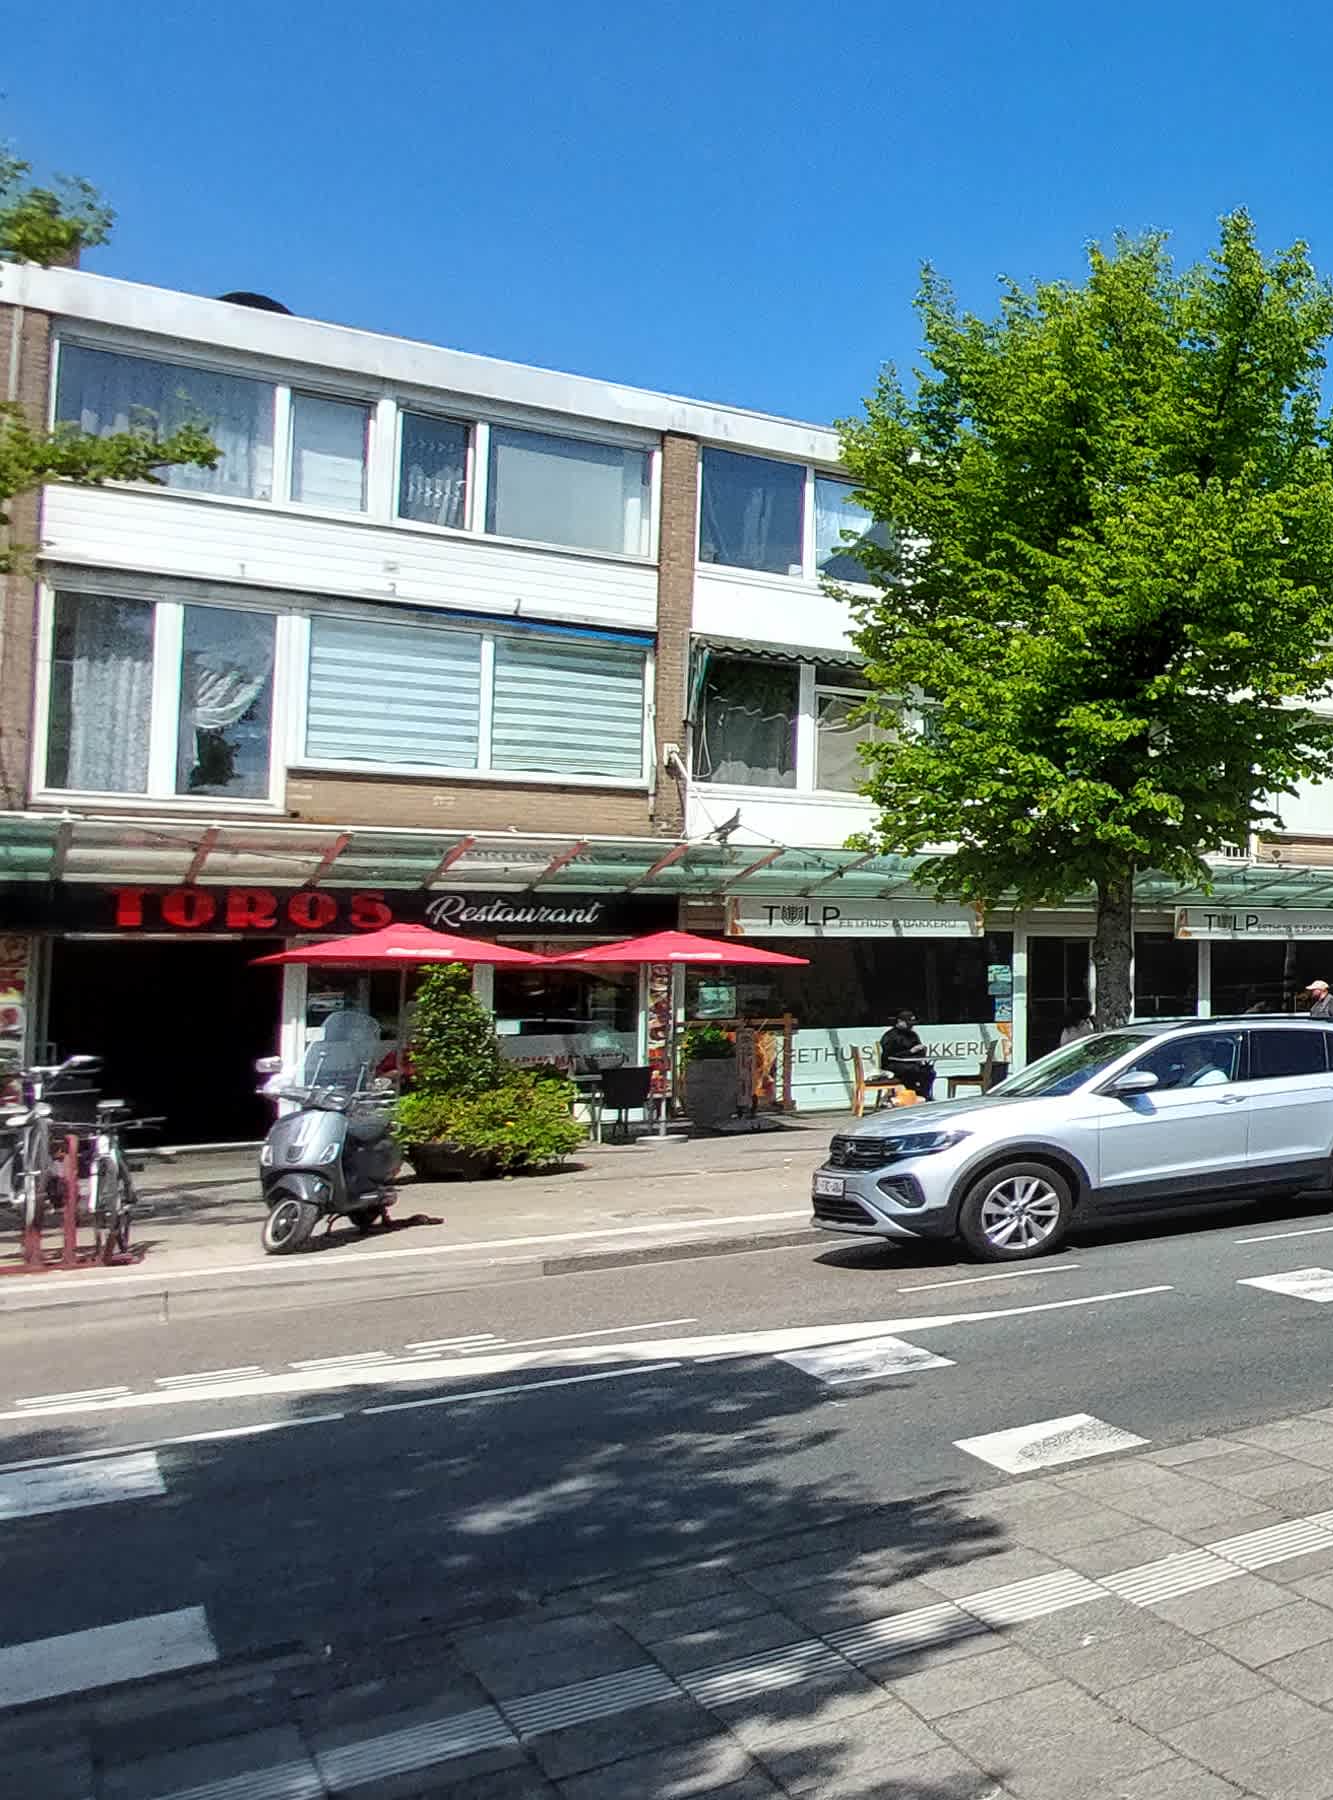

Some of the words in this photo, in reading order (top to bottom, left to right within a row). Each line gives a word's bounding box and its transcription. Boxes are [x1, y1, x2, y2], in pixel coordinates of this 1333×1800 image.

[112, 886, 393, 930] TOROS
[426, 895, 605, 927] Restaurant
[788, 1045, 873, 1063] ETHUS
